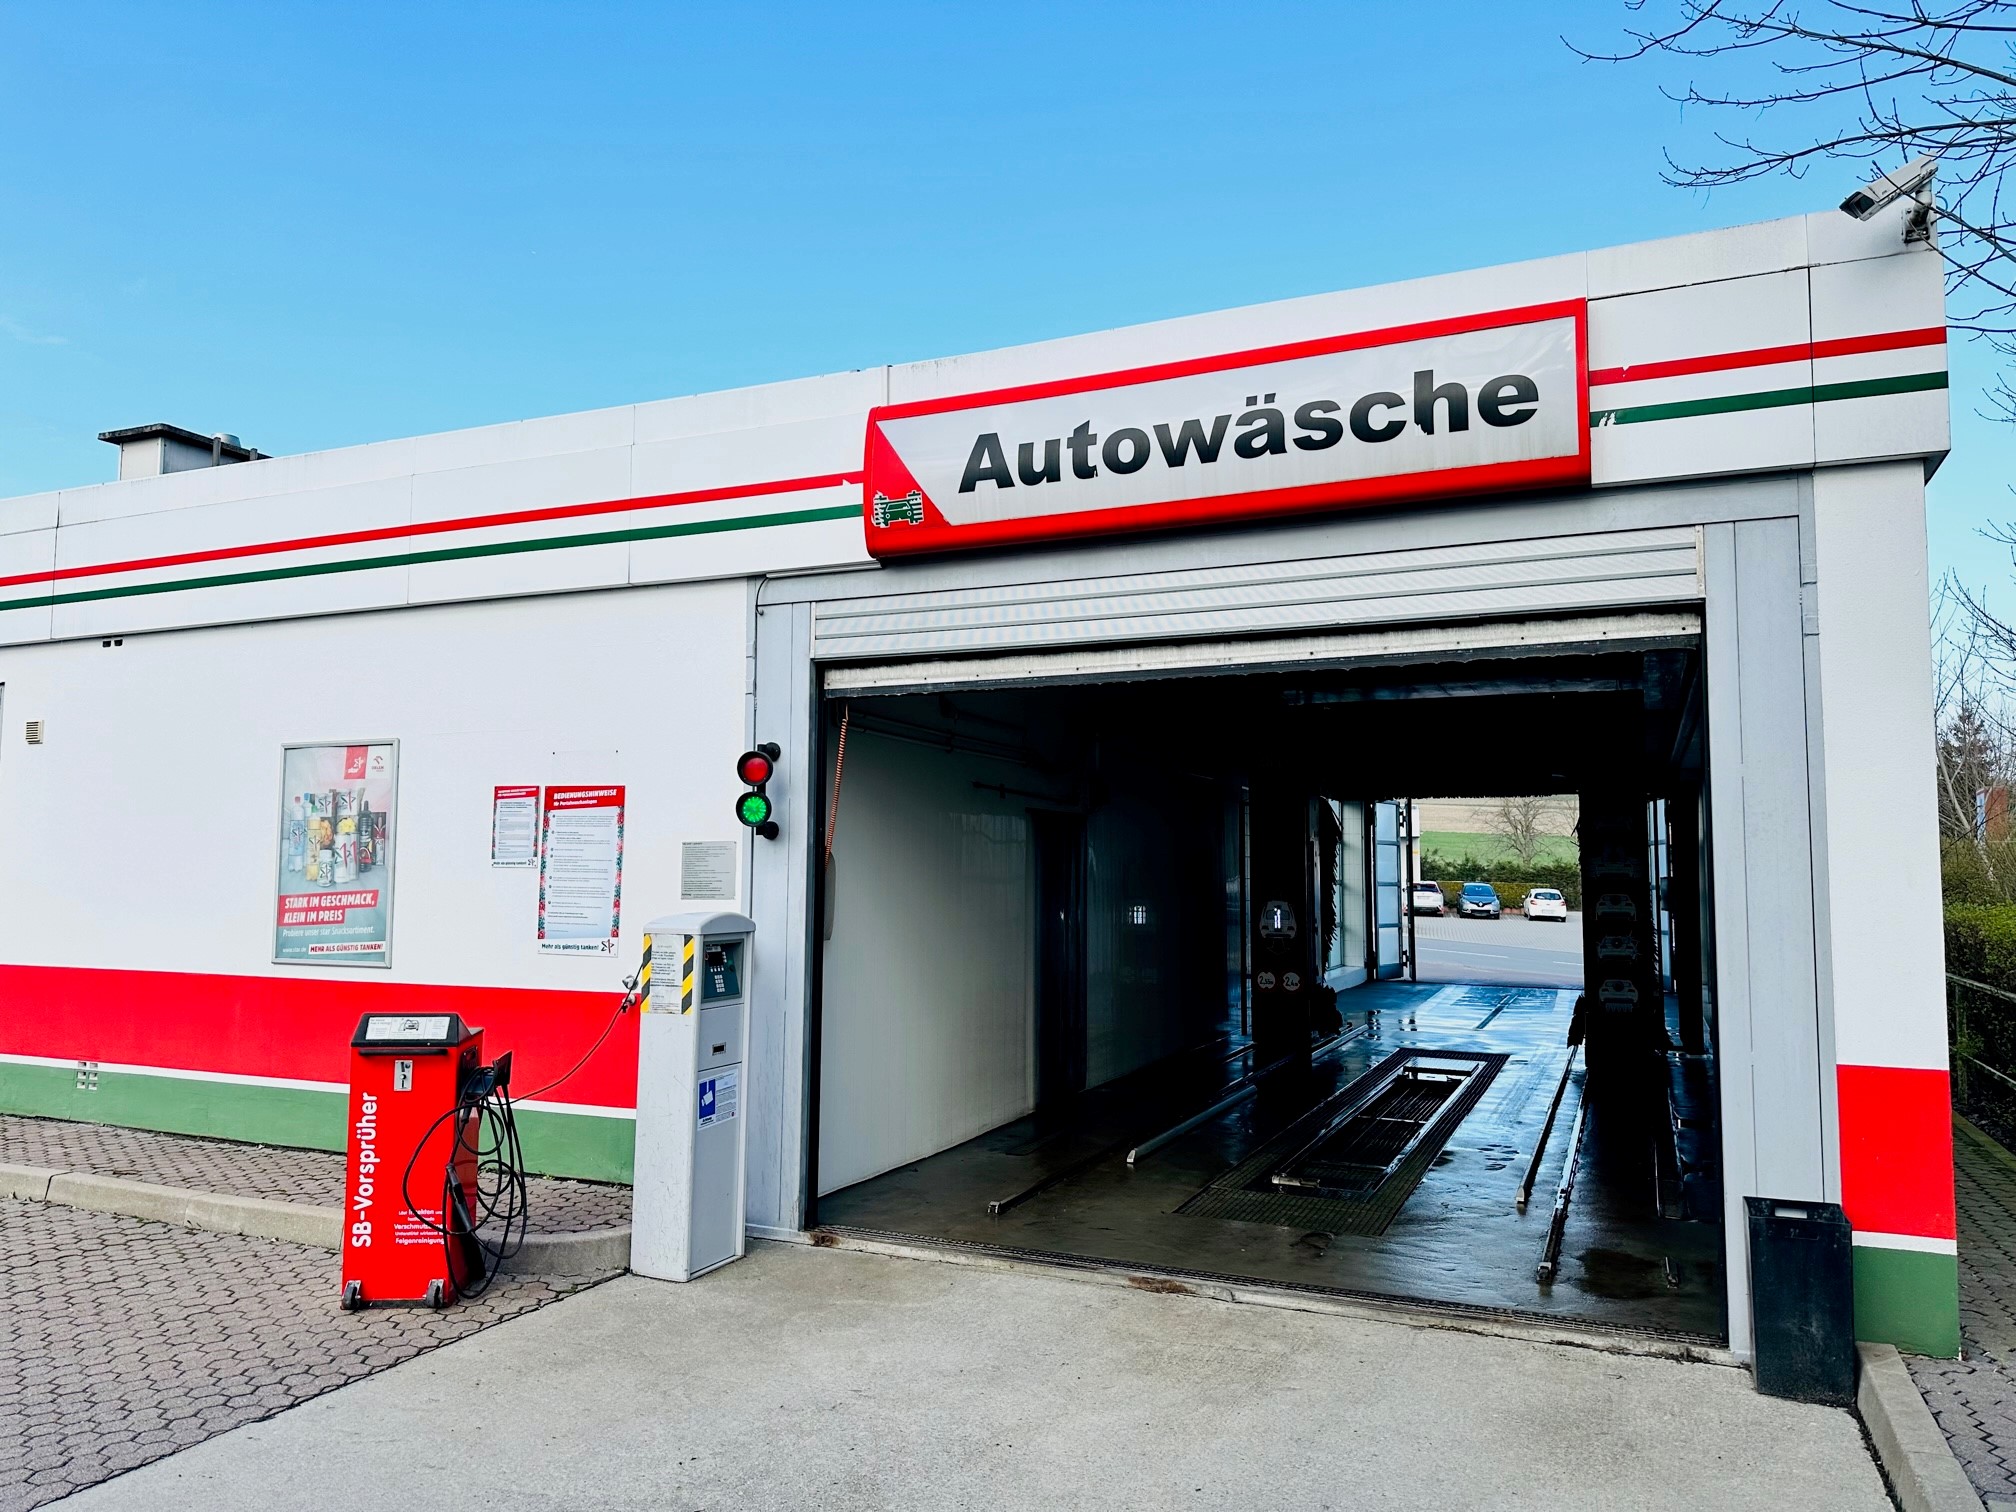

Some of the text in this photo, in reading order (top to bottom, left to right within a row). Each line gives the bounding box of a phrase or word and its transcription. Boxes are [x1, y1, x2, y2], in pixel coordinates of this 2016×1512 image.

[958, 369, 1539, 493] Autowäsche
[553, 789, 617, 800] BEDIENUNGSHINWEISE
[284, 893, 375, 909] STARK IM GESCHMACK,
[283, 909, 343, 923] KLEIN IM PREIS
[325, 944, 335, 952] ALS
[336, 943, 359, 951] GÜNSTIG
[351, 1092, 381, 1248] SB-Vorsprüher
